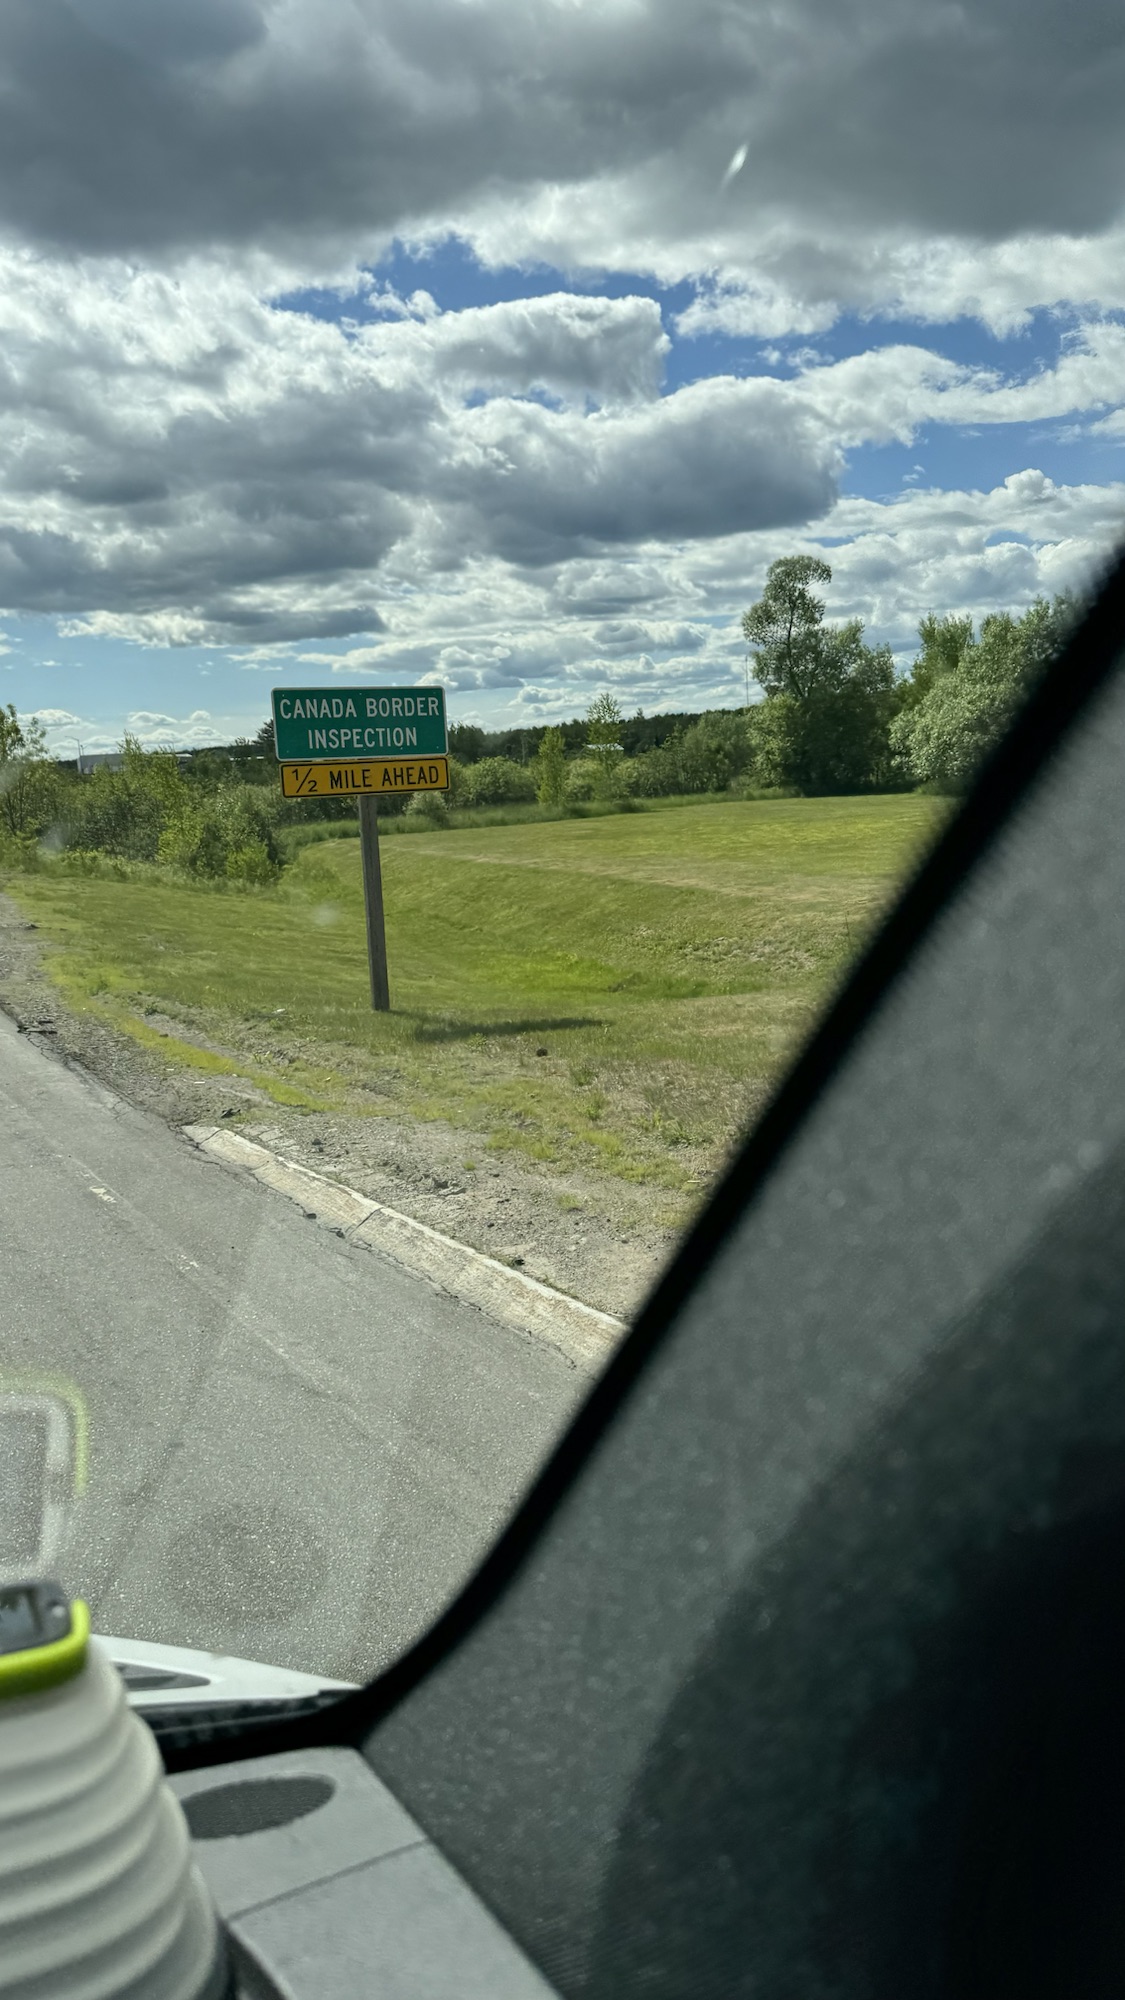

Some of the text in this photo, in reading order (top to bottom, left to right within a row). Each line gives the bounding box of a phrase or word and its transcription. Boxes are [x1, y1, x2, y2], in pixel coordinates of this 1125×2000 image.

[280, 697, 439, 719] CANADA BORDER
[308, 727, 418, 749] INSPECTION
[329, 769, 372, 789] MILE
[382, 766, 439, 787] AHEAD
